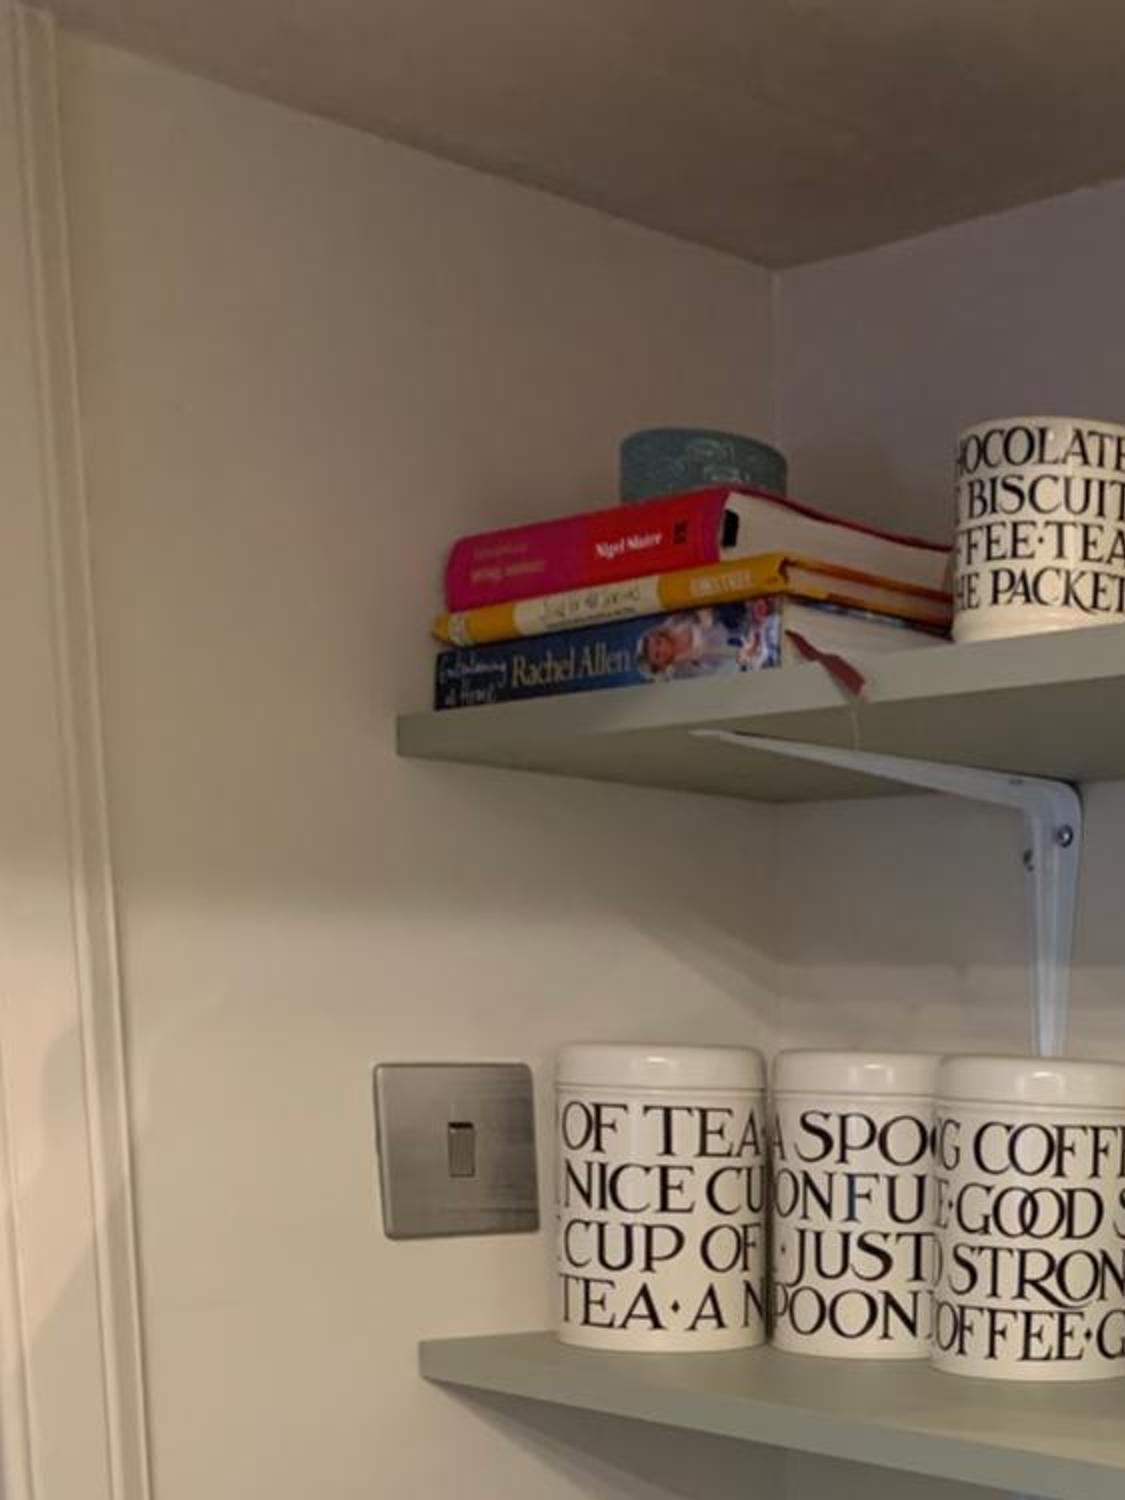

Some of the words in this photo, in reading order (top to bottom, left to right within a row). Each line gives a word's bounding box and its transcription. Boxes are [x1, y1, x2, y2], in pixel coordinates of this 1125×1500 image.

[512, 645, 577, 689] Rachel
[579, 640, 632, 678] Allen
[562, 1101, 628, 1153] OF
[565, 1158, 695, 1214] NICE
[564, 1218, 686, 1273] CUP
[700, 1223, 763, 1273] OF
[770, 1282, 935, 1341] POON
